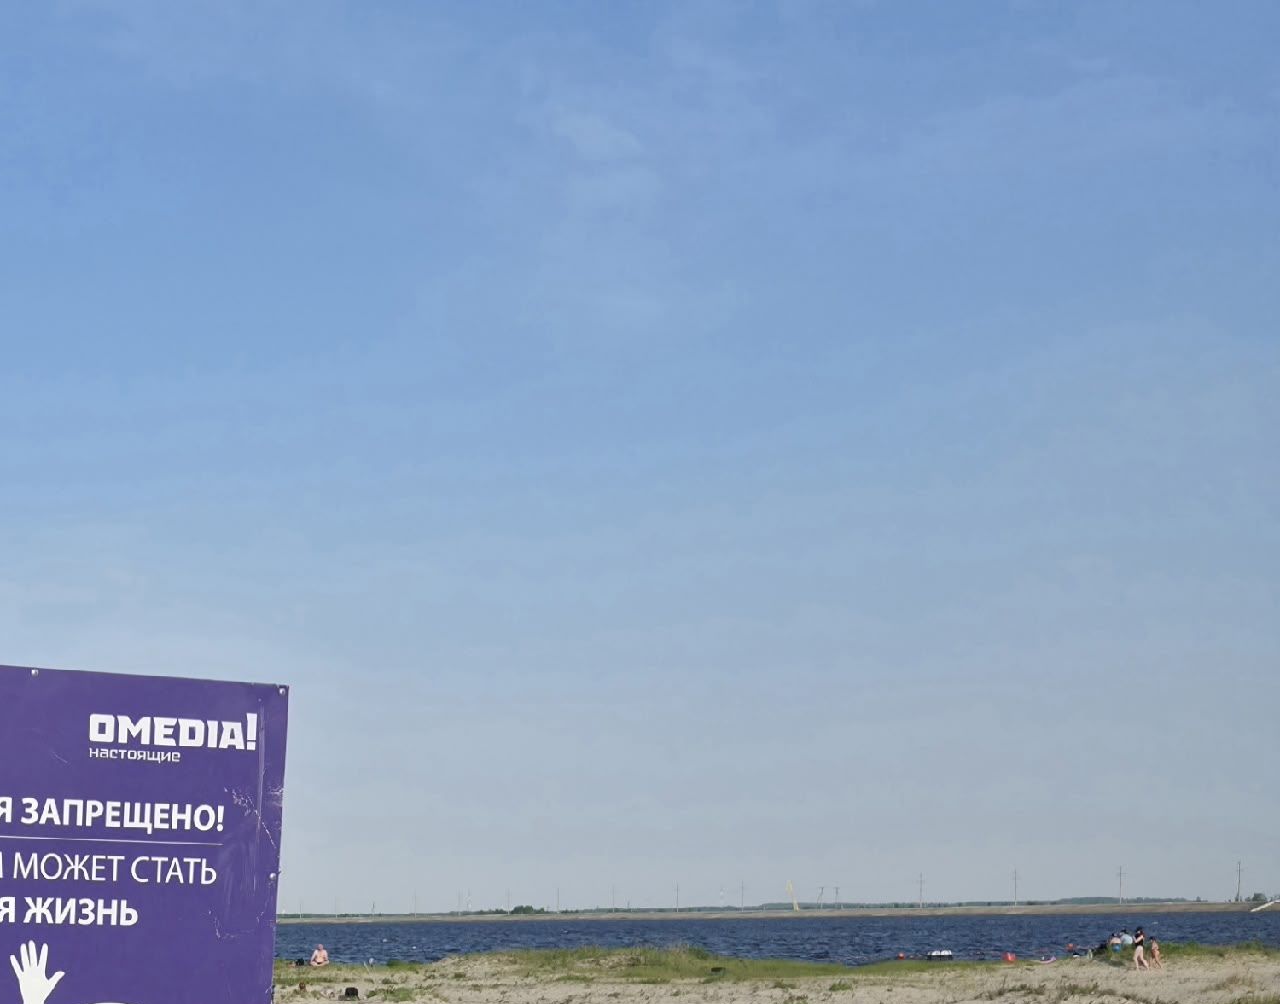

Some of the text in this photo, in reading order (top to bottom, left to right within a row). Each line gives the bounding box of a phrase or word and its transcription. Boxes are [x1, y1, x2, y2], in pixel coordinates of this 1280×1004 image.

[89, 712, 258, 751] OMEDIA!
[89, 747, 181, 764] настоящие
[20, 797, 225, 835] ЗАПРЕЩЕНО!
[13, 851, 126, 883] МОЖЕТ
[130, 855, 217, 886] СТАТЬ
[22, 896, 139, 927] ЖИЗНЬ
